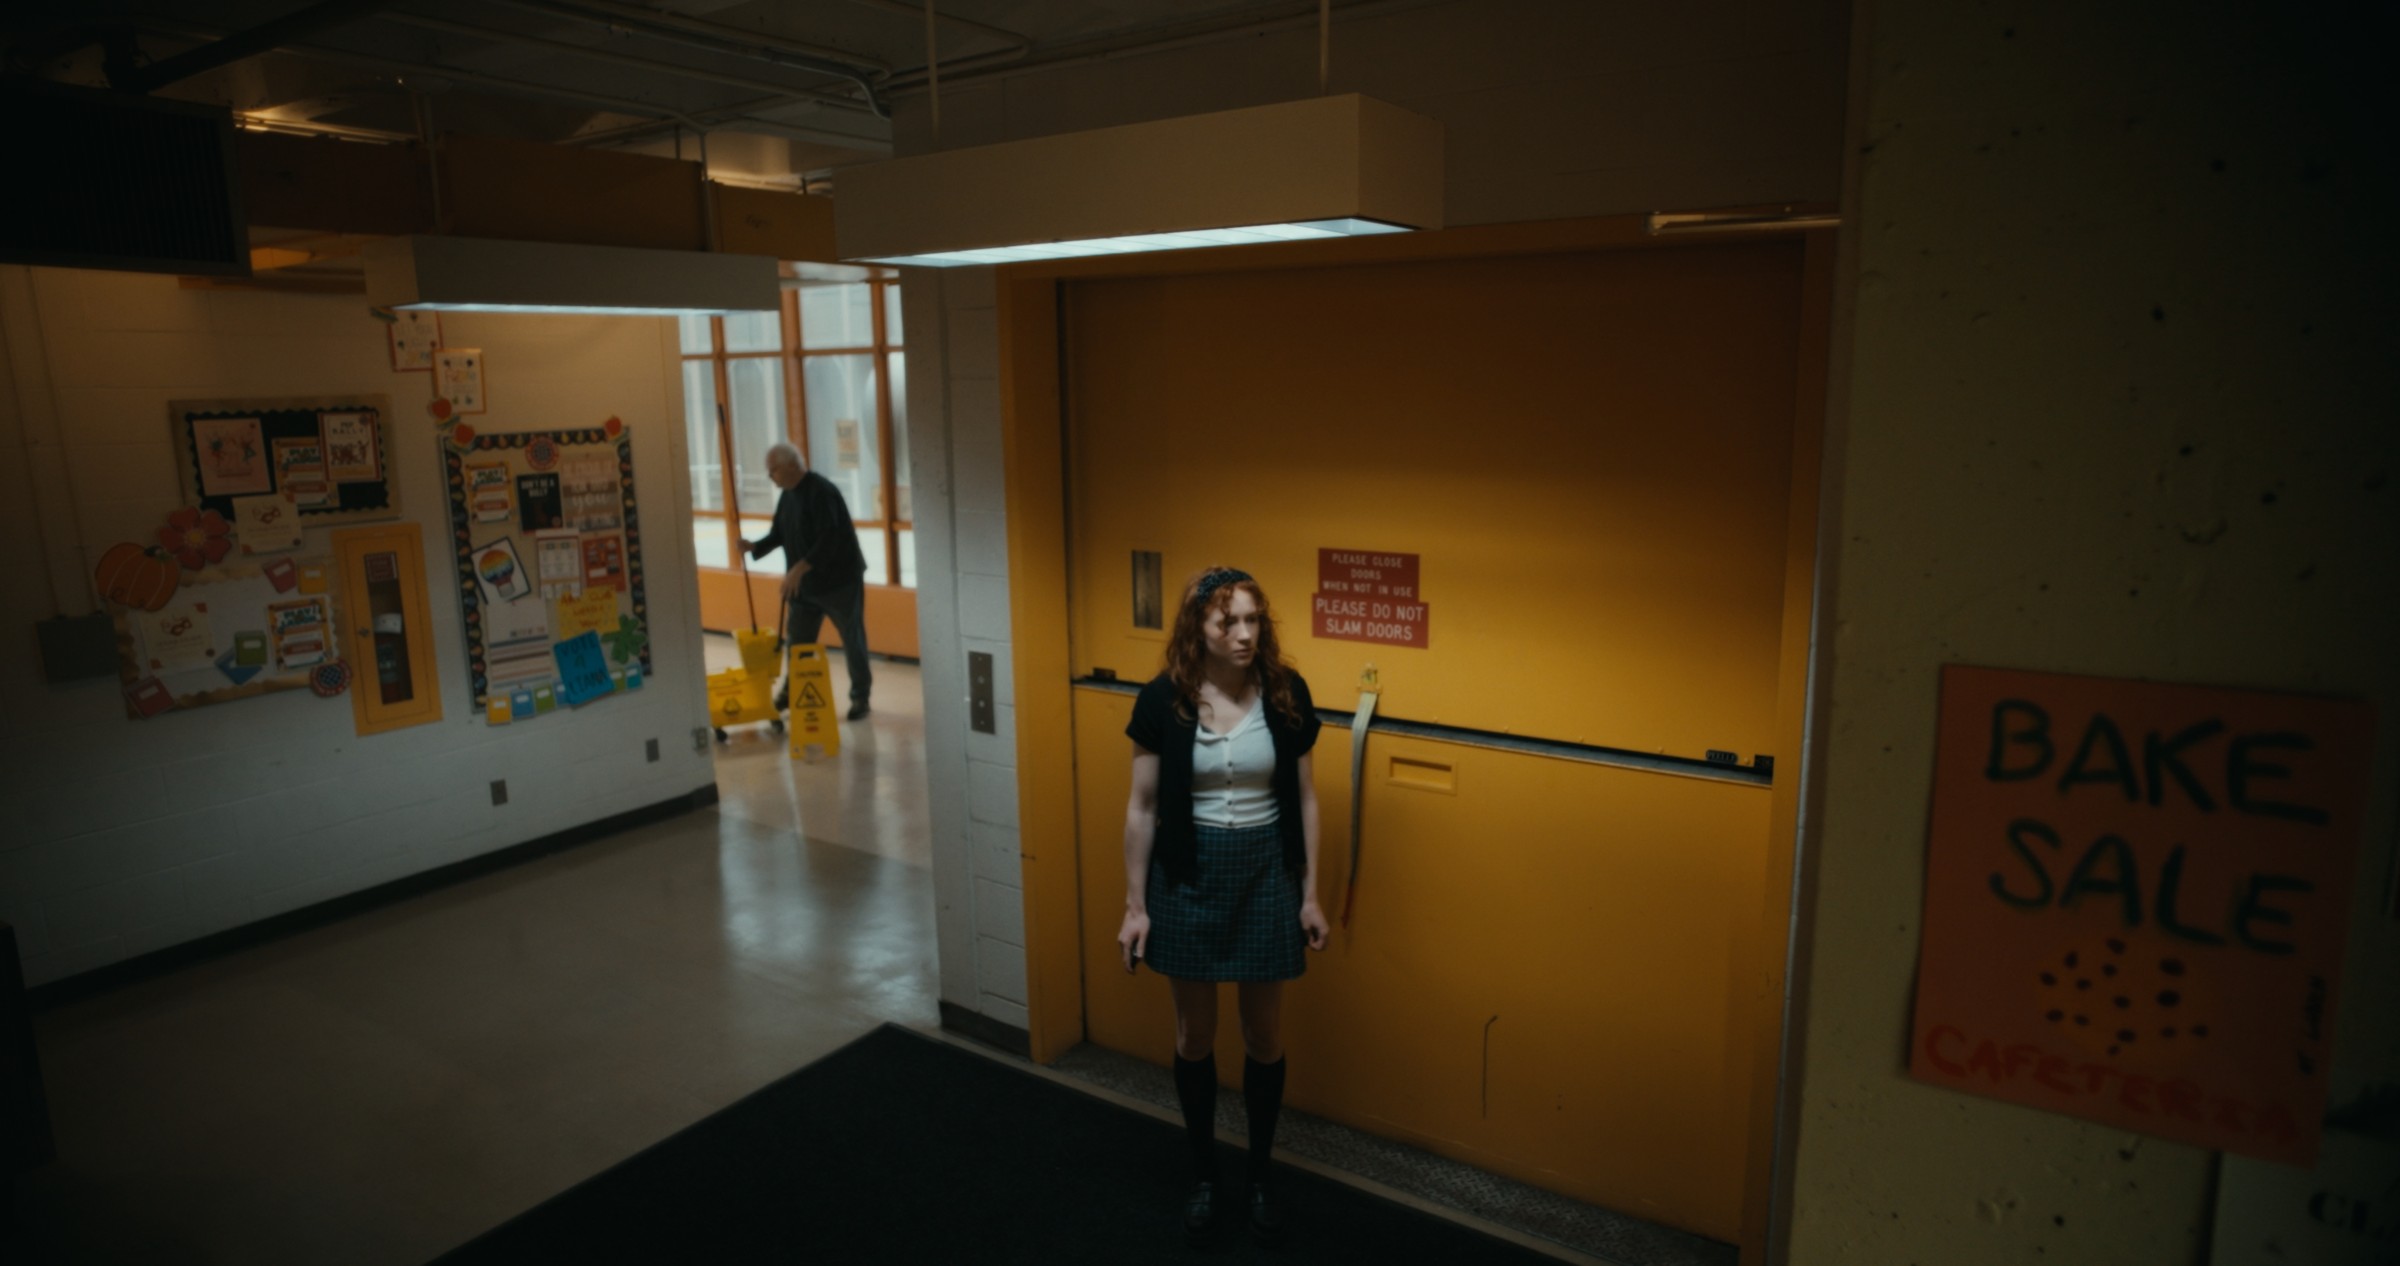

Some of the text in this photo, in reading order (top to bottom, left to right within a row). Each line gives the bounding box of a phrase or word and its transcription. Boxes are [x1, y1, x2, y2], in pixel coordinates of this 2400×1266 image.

[1331, 552, 1403, 569] PLEASE CLOSE
[1350, 568, 1382, 580] DOORS
[1322, 580, 1413, 598] WHEN NOT IN USE
[1315, 597, 1424, 622] PLEASE DO NOT
[1325, 617, 1413, 641] SLAM DOORS
[560, 632, 598, 656] VOTE
[1985, 699, 2331, 826] BAKE
[1988, 816, 2316, 955] SALE
[1925, 1024, 2300, 1147] CAFETERIA
